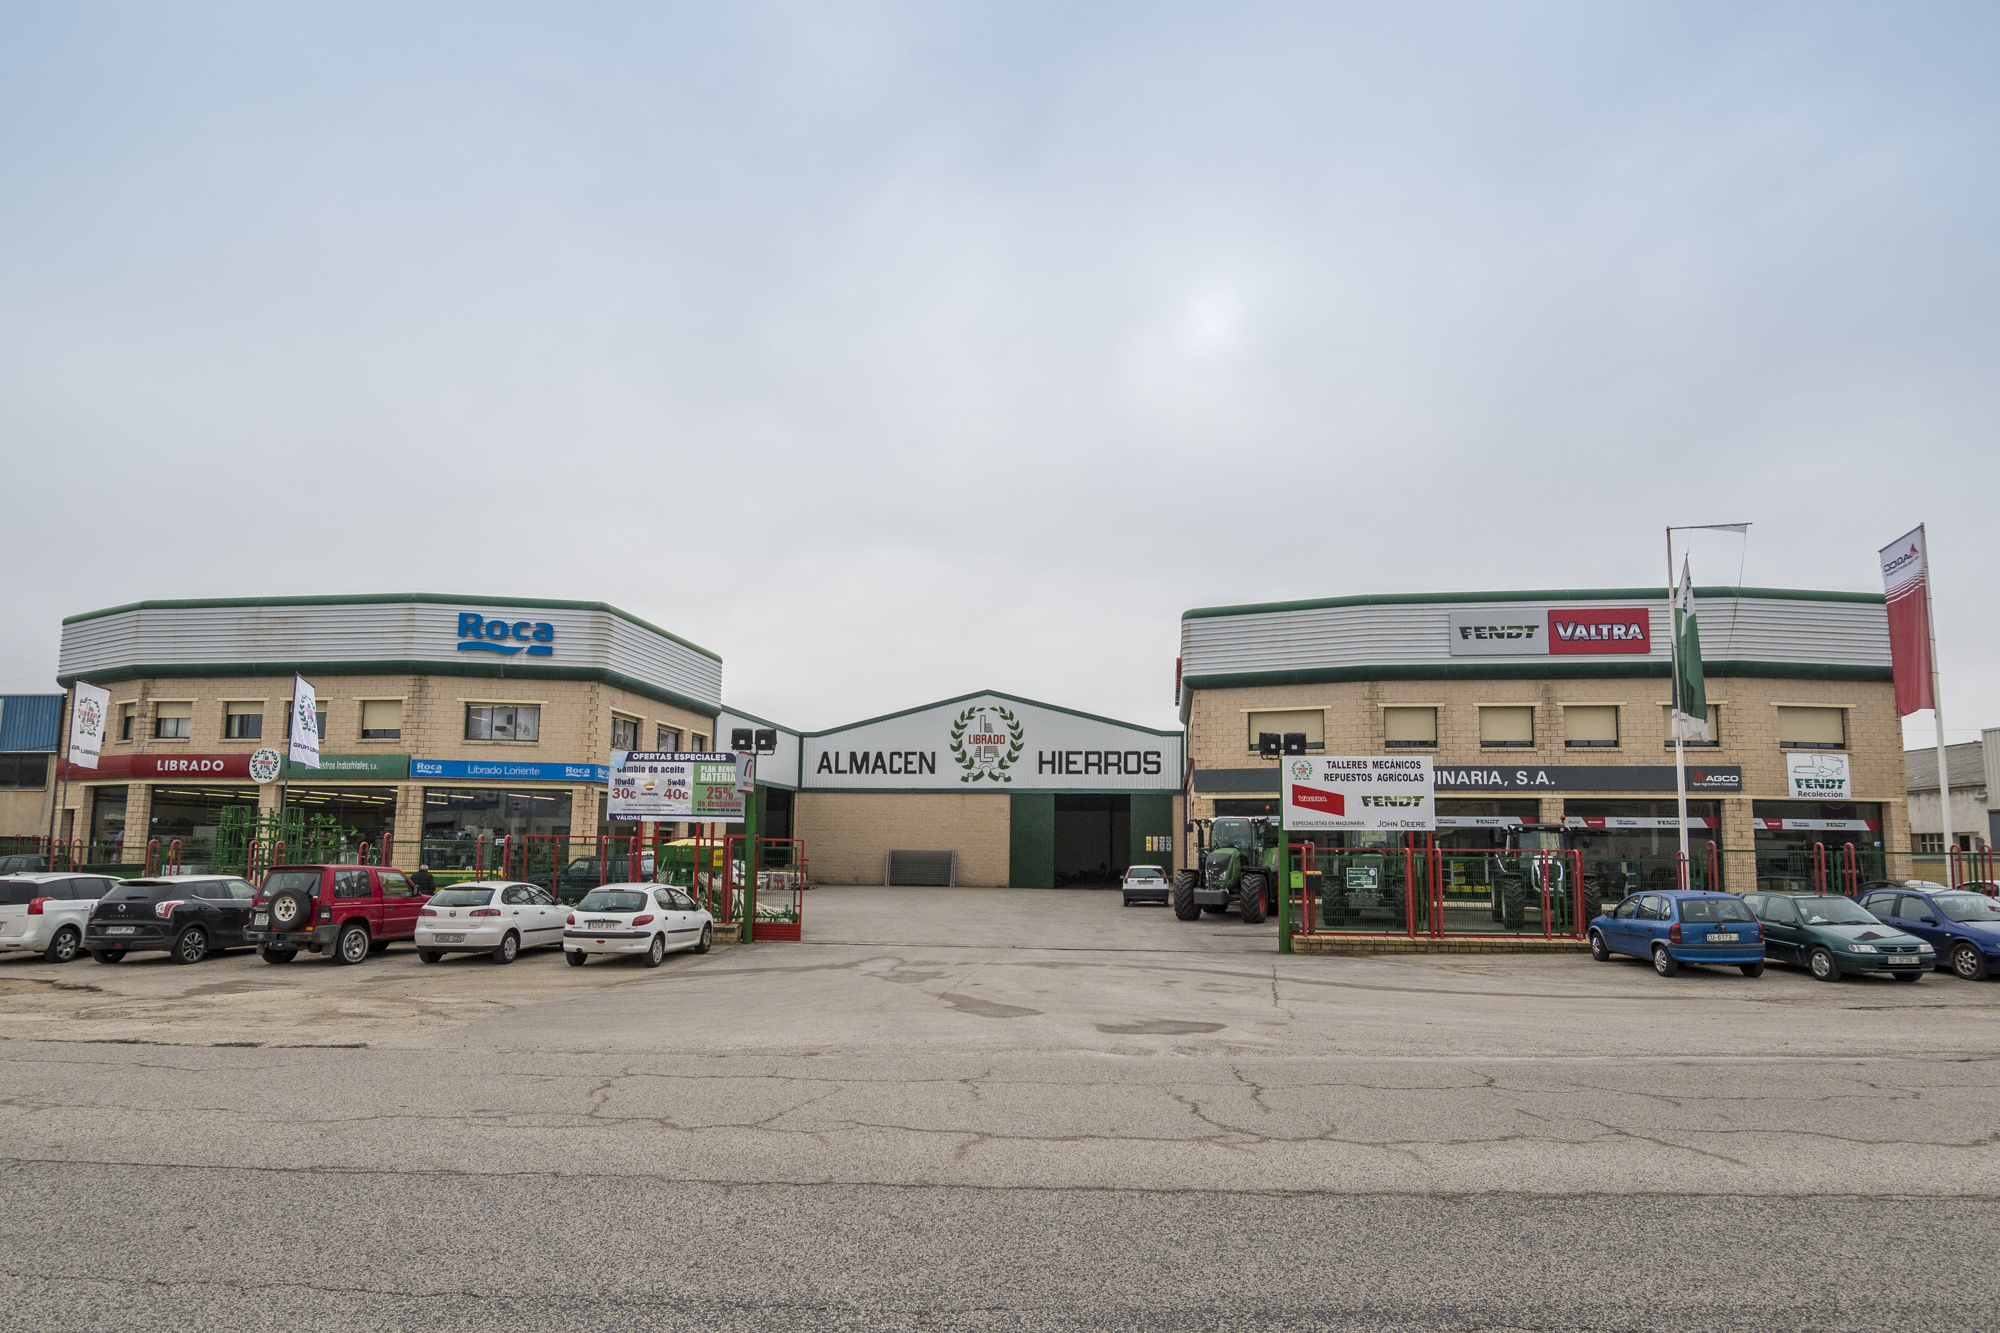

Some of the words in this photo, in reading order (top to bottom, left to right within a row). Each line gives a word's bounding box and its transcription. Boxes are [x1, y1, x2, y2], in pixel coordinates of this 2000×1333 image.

[457, 612, 554, 641] Roca
[1554, 622, 1645, 641] VALTRA
[1458, 625, 1539, 640] FENDT
[968, 734, 1006, 745] LIBRADO
[632, 753, 672, 761] OFERTAS
[674, 753, 727, 761] ESPECIALES
[156, 759, 225, 772] LIBRADO
[336, 761, 370, 772] Industriales,
[416, 762, 442, 771] Roca
[816, 751, 936, 775] ALMACEN
[1038, 751, 1162, 775] HIERROS
[1326, 760, 1368, 769] TALLERES
[1372, 759, 1421, 769] MECÁNICOS
[467, 765, 502, 775] Librado
[504, 766, 541, 776] Loriente
[565, 766, 590, 775] Roca
[648, 765, 659, 774] de
[660, 765, 685, 774] aceite
[700, 765, 717, 773] PLAN
[614, 778, 635, 786] 10w40
[1324, 773, 1373, 782] REPUESTOS
[1377, 771, 1425, 782] AGRÍCOLAS
[1433, 770, 1509, 787] INARIA,
[1515, 770, 1556, 785] S.A.
[667, 778, 686, 787] 5w40
[1794, 778, 1846, 789] FENDT
[611, 787, 637, 799] 30€
[663, 788, 689, 800] 40€
[706, 786, 734, 800] 25%
[1797, 790, 1844, 798] Recolección
[707, 800, 742, 808] descuento
[1361, 795, 1425, 807] FENDT
[616, 813, 641, 821] VÁLIDAS
